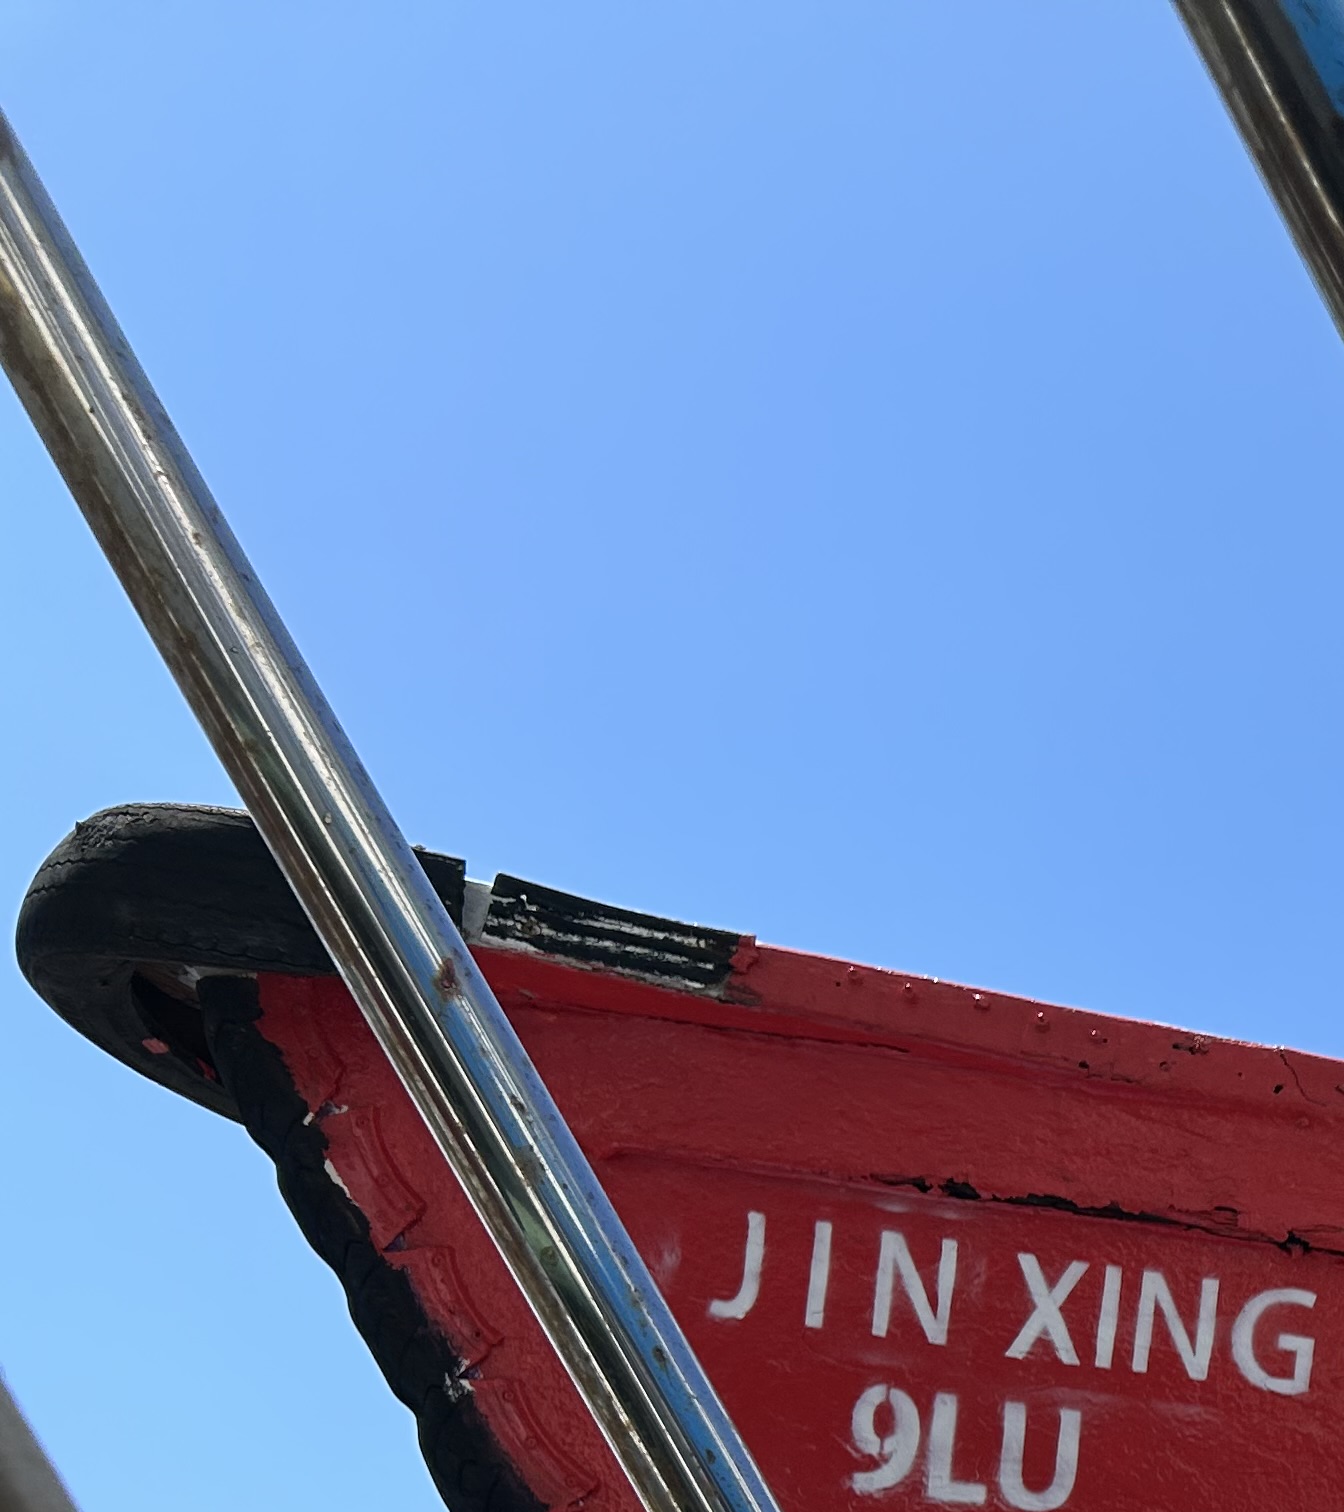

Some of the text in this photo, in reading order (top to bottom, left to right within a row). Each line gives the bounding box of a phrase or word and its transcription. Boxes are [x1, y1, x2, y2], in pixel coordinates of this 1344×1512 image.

[708, 1211, 1317, 1396] JIN XING
[849, 1383, 1082, 1512] 9LU
